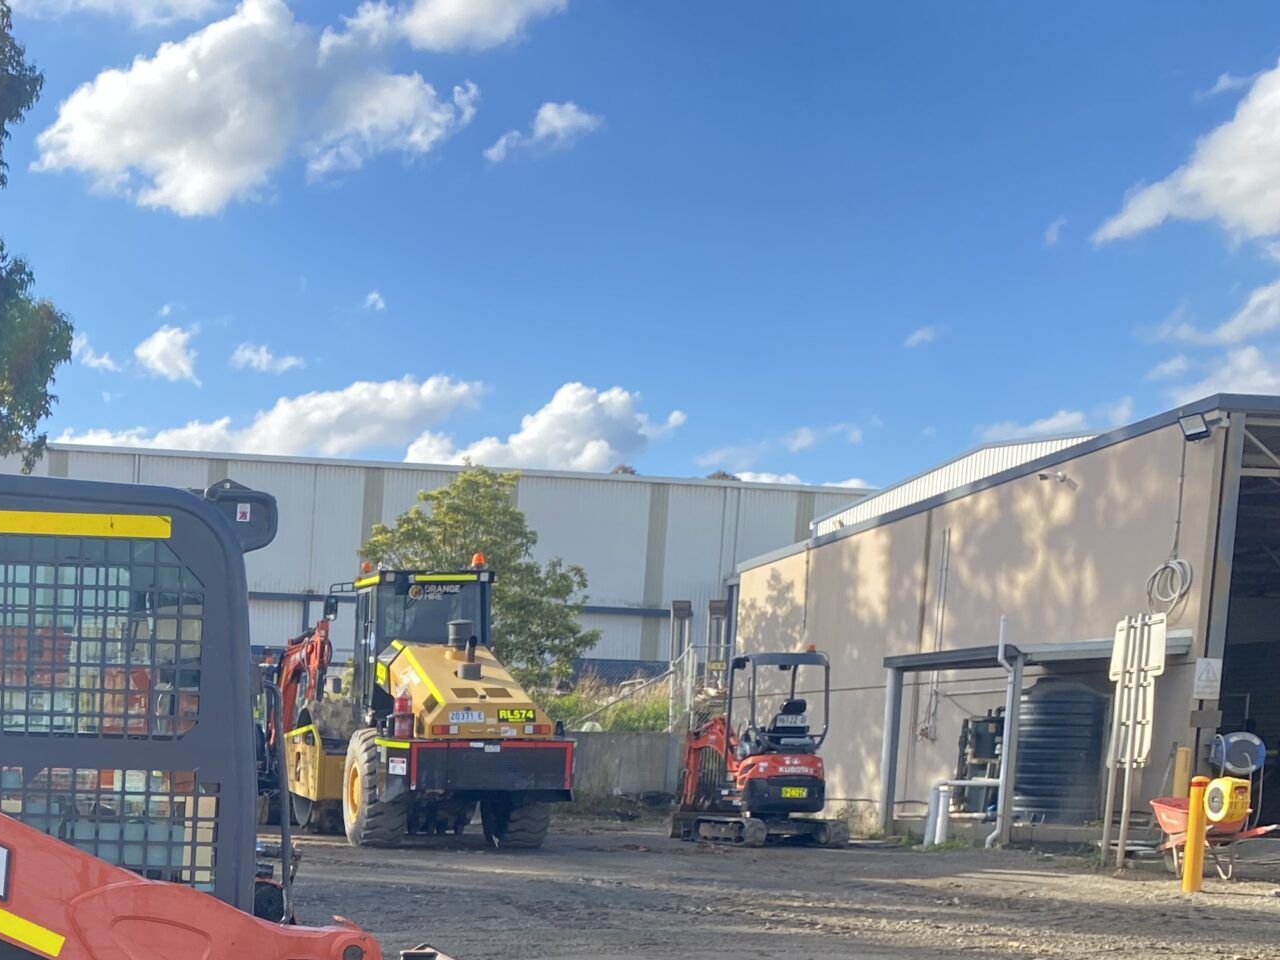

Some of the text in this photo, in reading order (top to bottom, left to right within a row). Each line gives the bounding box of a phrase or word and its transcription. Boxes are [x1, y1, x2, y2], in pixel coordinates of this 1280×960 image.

[424, 585, 461, 593] ORANGE
[424, 592, 443, 600] HIRE
[499, 710, 534, 719] RL574
[778, 766, 809, 774] KUBOTA
